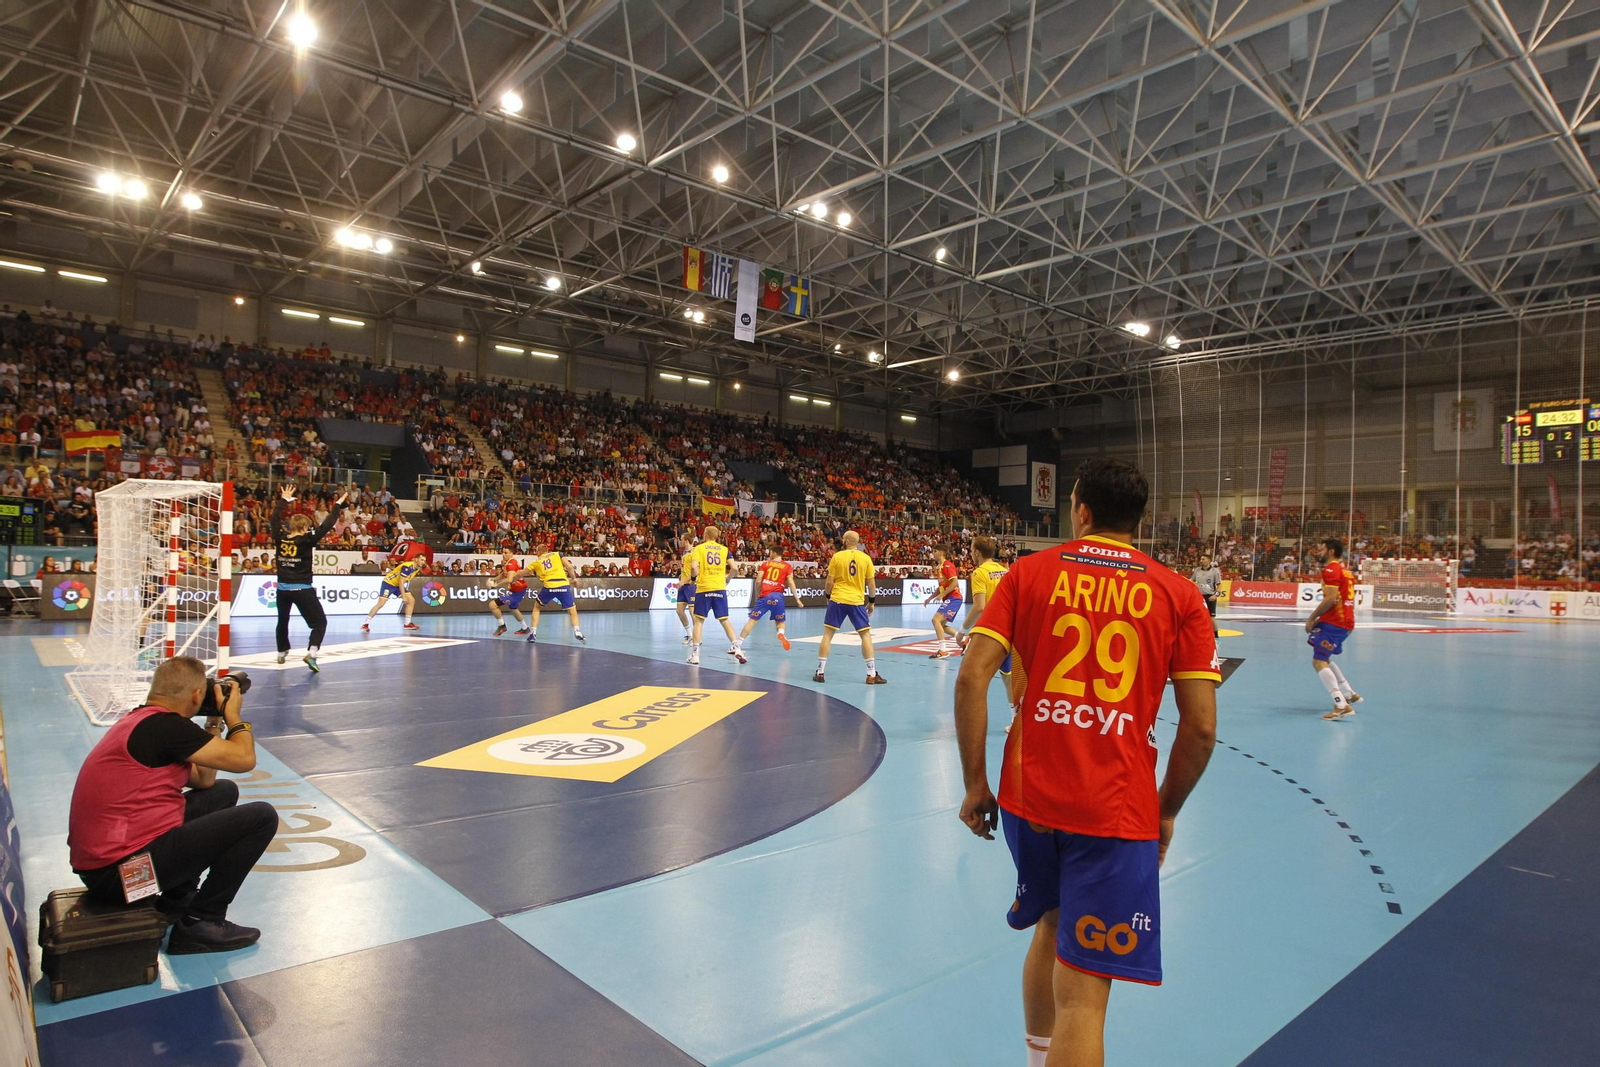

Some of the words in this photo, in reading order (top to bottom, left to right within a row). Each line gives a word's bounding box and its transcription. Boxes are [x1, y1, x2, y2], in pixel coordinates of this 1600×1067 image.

[1542, 412, 1576, 424] 24:32
[1515, 425, 1531, 436] 15
[1547, 432, 1555, 440] 0
[1564, 431, 1572, 440] 2
[1556, 450, 1562, 458] 1
[22, 514, 33, 523] 08
[280, 543, 297, 557] 30
[1078, 544, 1132, 559] Joma
[541, 559, 553, 570] 18
[706, 551, 721, 565] 66
[1077, 557, 1129, 568] SPAGNOLO
[767, 567, 779, 581] 10
[848, 559, 856, 576] 6
[574, 586, 649, 600] LaLigaSports
[1049, 570, 1152, 619] ARIÑO
[1246, 589, 1294, 600] Santander
[1043, 612, 1140, 703] 29
[592, 691, 711, 730] Correos
[1034, 698, 1134, 736] sacyr
[1132, 912, 1152, 932] fit
